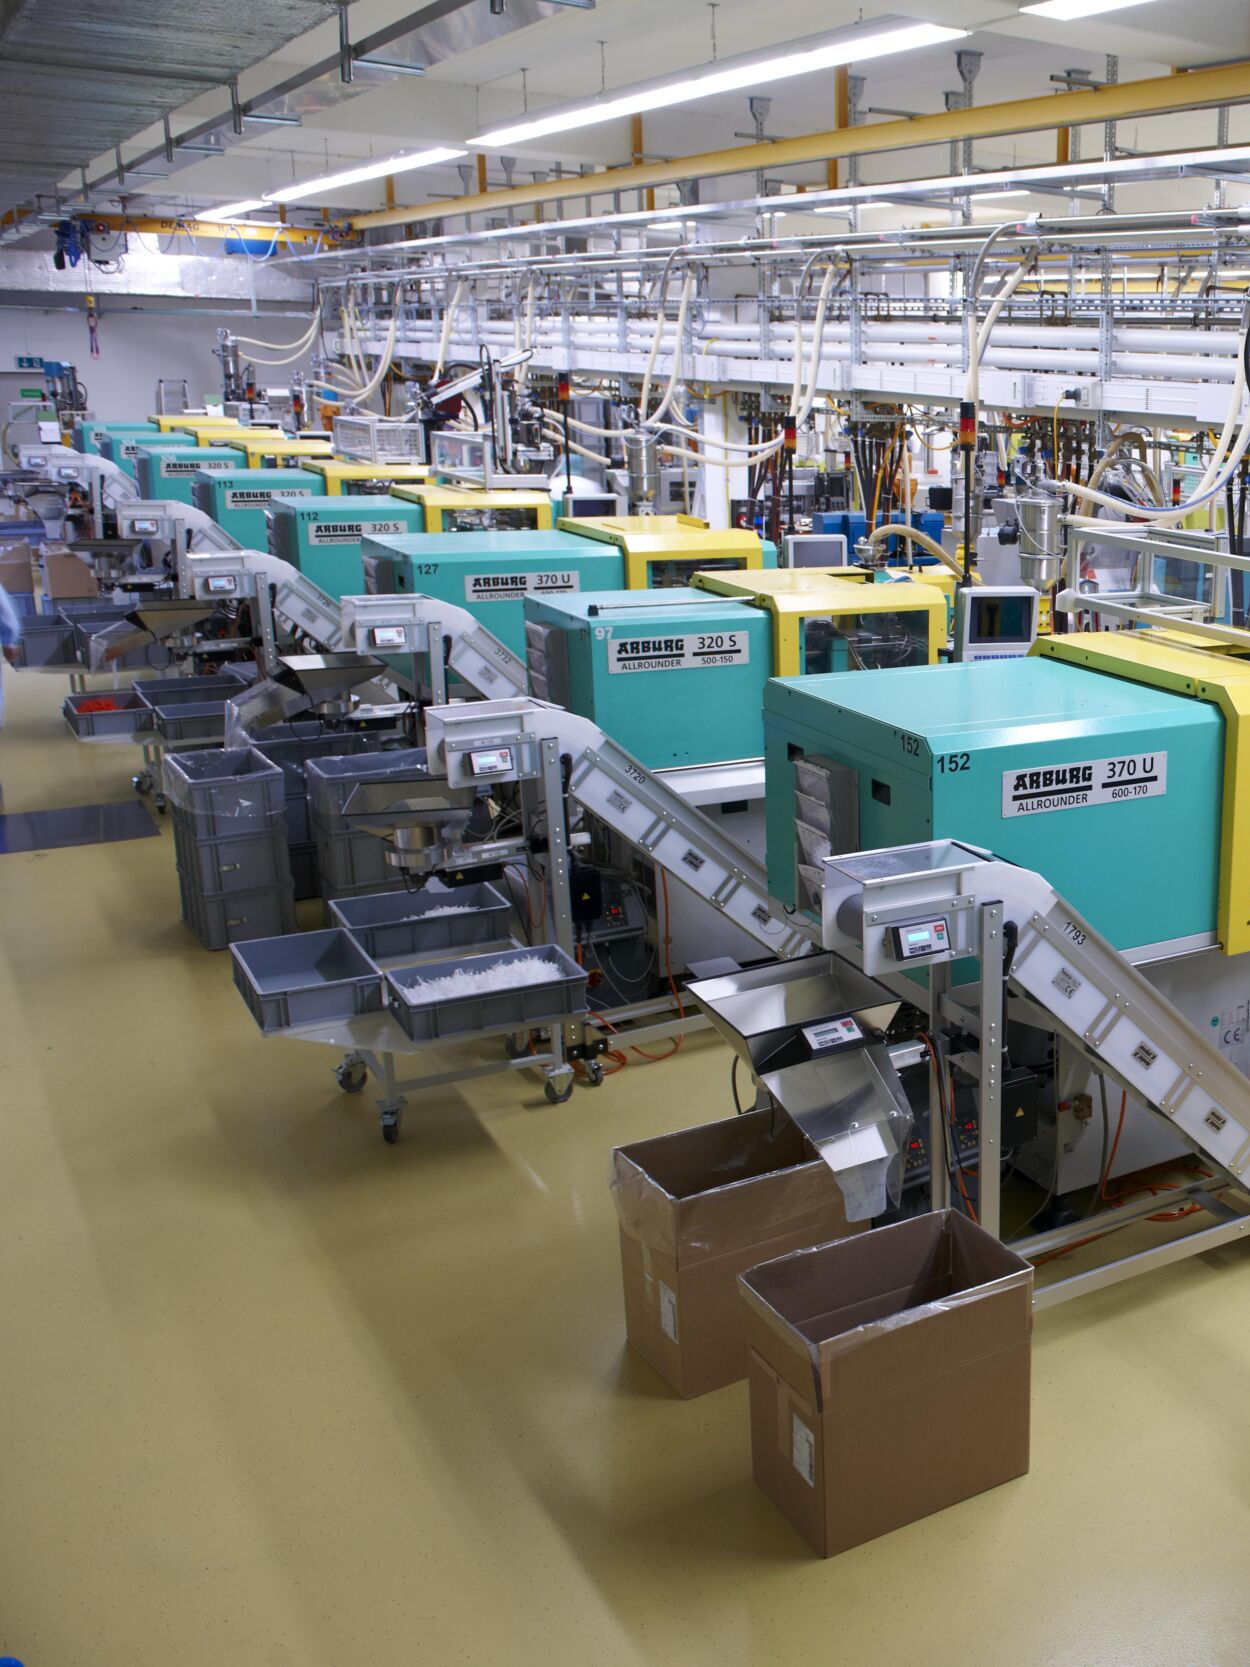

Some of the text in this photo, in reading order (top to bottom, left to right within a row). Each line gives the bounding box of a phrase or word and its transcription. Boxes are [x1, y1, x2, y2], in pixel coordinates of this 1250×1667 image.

[217, 481, 234, 489] 113
[231, 491, 272, 499] ARBURG
[300, 512, 319, 521] 112
[315, 523, 399, 533] ARBURG 320 S
[416, 563, 439, 575] 127
[472, 573, 571, 588] ARBURG 370 U
[594, 627, 613, 640] 97
[617, 634, 737, 655] ARBURG 320 S
[621, 655, 734, 671] ALLROUNDER 500-150
[900, 735, 920, 757] 152
[937, 752, 970, 774] 152
[624, 764, 646, 784] 3720
[1012, 756, 1155, 792] ARBURG 370 U
[1017, 784, 1148, 813] ALLROUNDER 600-170
[1063, 921, 1087, 946] 1793
